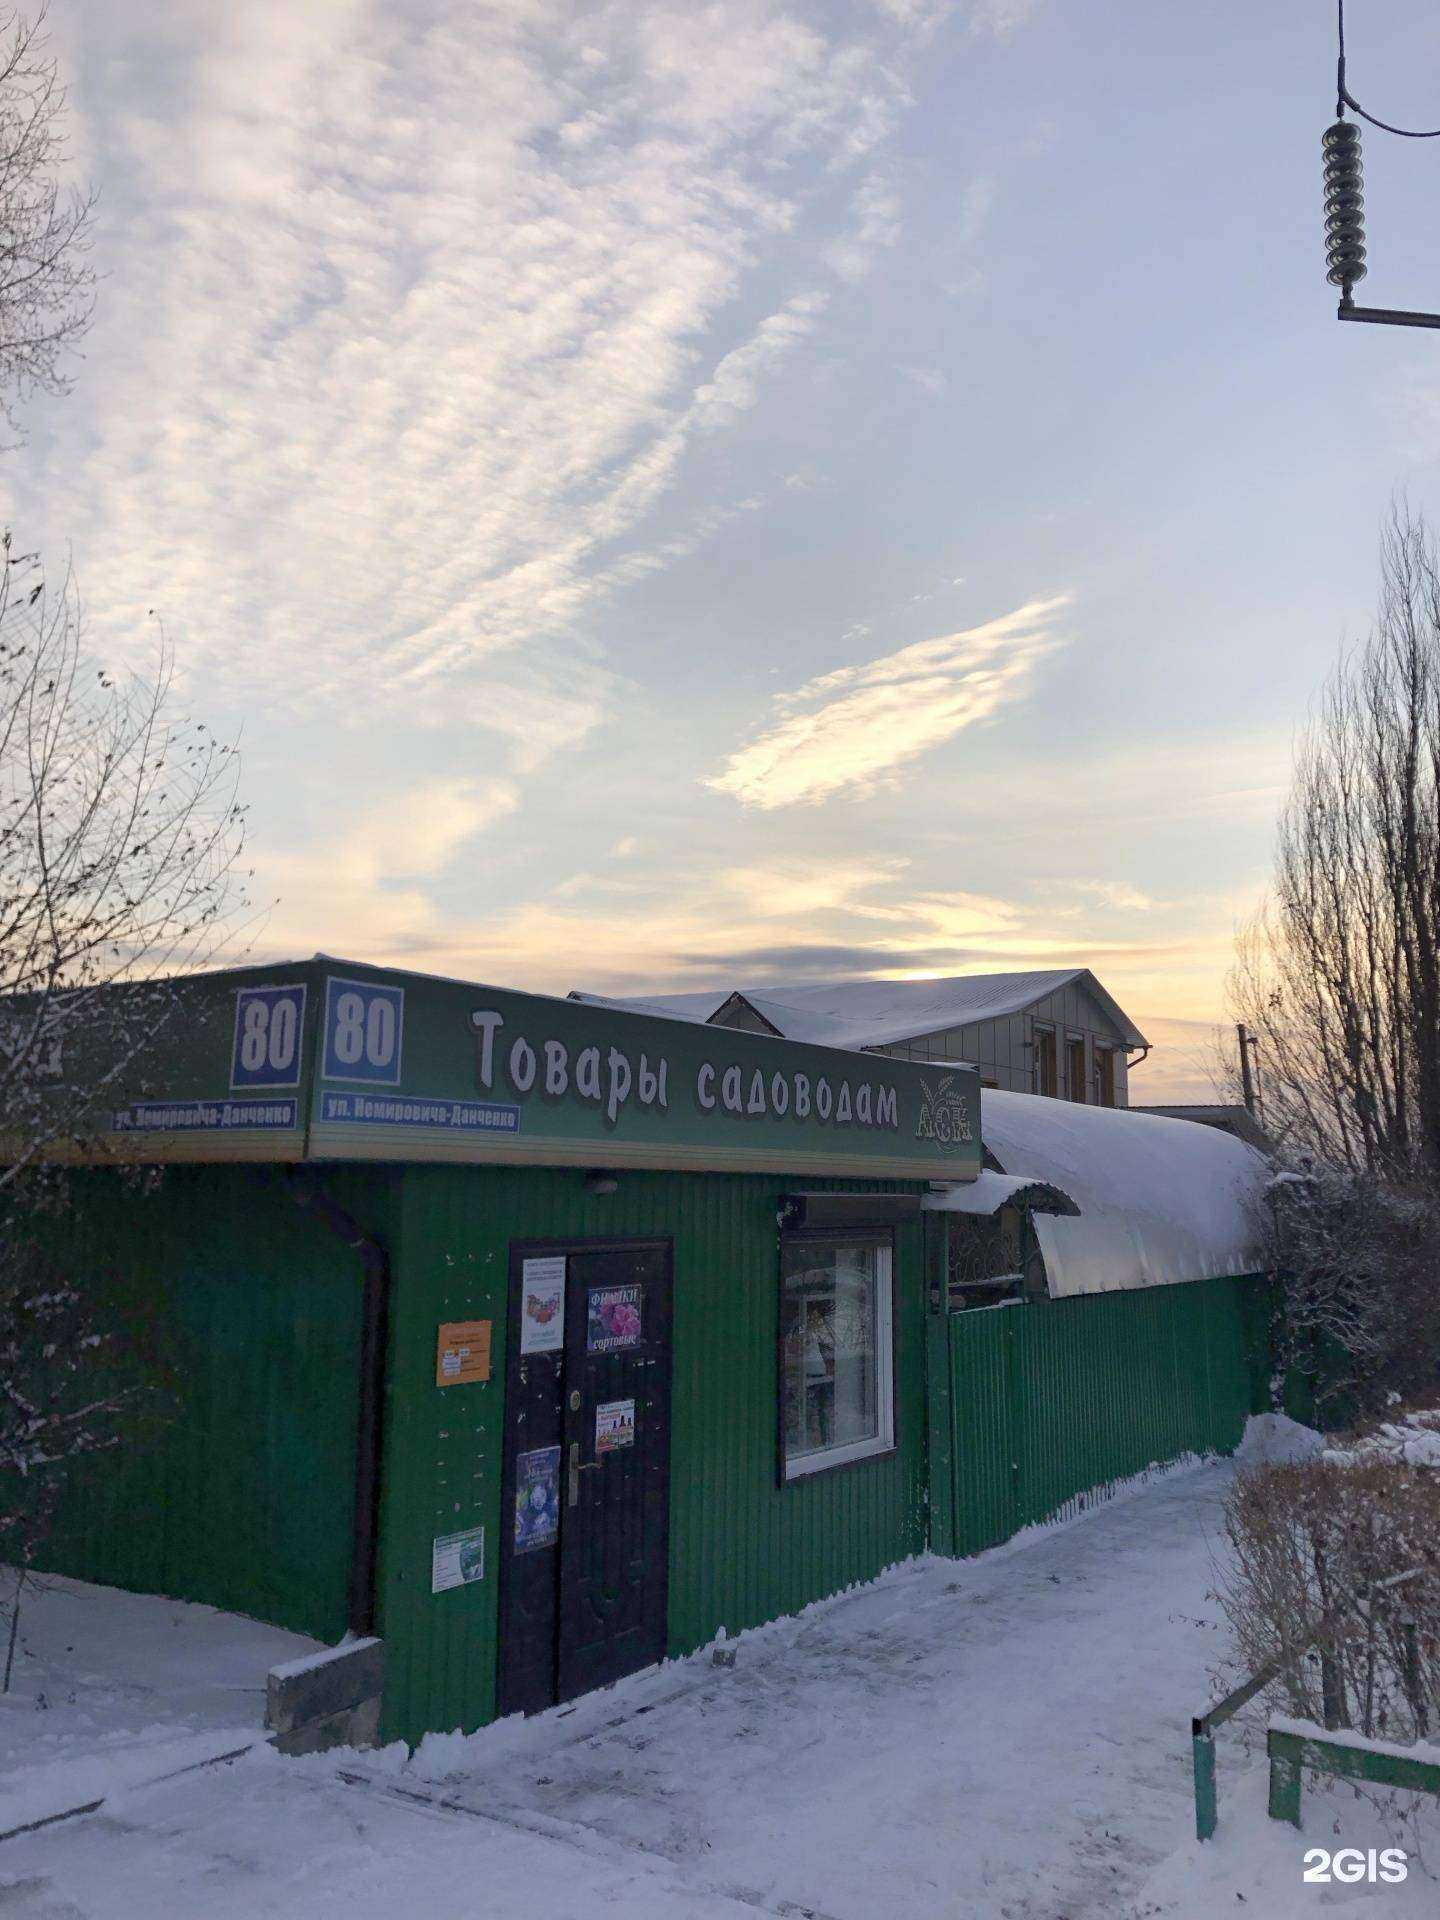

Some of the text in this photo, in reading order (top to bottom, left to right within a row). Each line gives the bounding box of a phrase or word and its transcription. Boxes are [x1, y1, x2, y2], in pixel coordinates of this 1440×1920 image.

[242, 998, 298, 1071] 80
[335, 992, 395, 1067] 80
[472, 1011, 899, 1128] Товары садоводам
[355, 1098, 515, 1126] Немировича-Данченко
